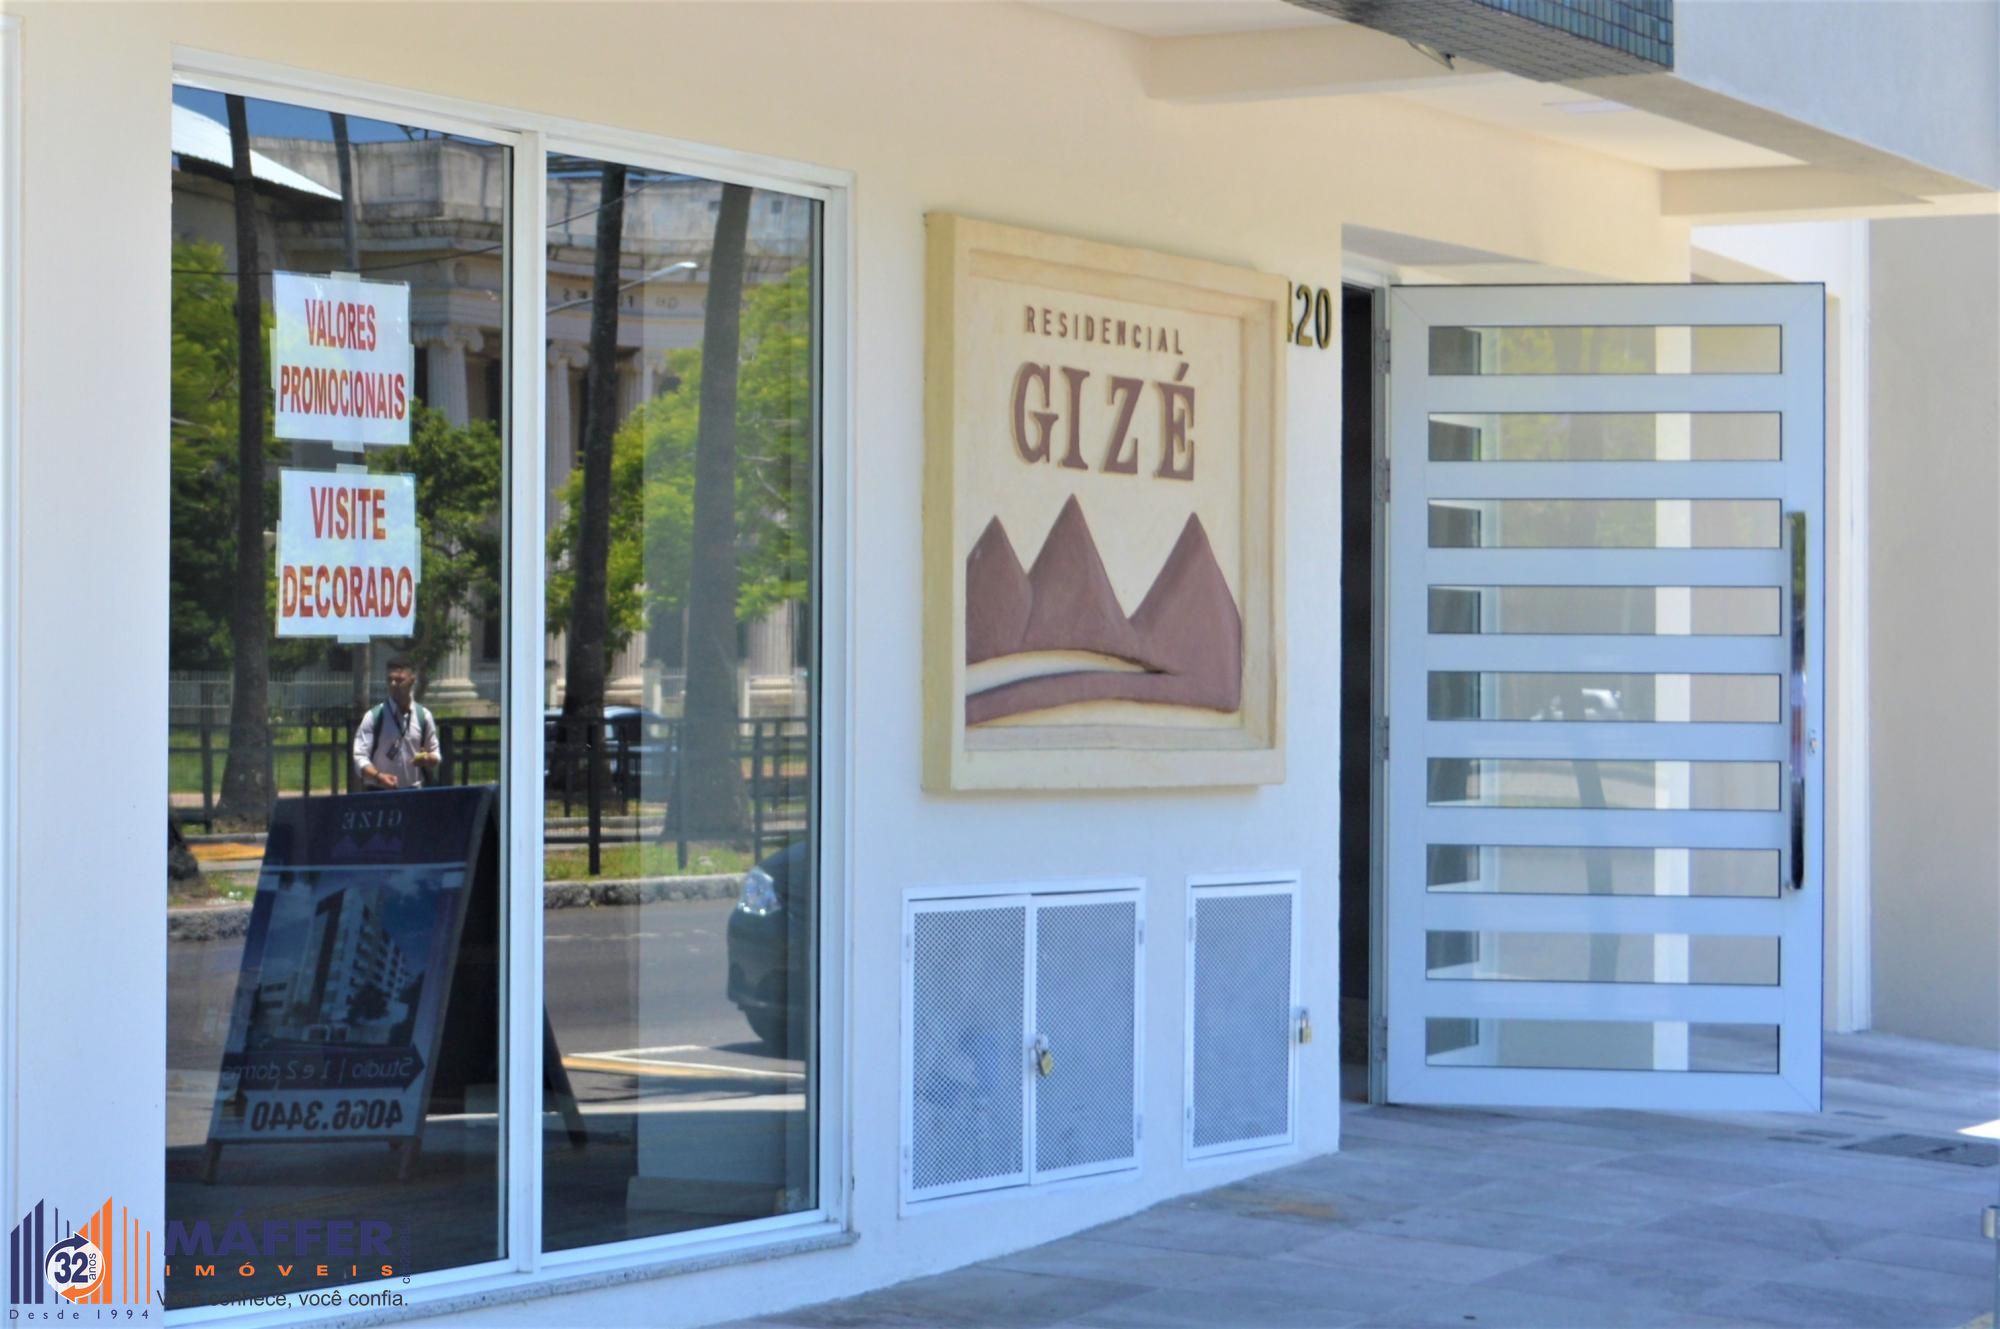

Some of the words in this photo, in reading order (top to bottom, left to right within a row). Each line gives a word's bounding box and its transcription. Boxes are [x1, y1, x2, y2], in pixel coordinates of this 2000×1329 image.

[305, 299, 376, 352] VALORES
[1024, 305, 1184, 355] RESIDENCIAL
[280, 364, 405, 421] PROMOCIONAIS
[1010, 362, 1195, 481] GIZÉ
[310, 486, 386, 540] VISITE
[282, 564, 413, 619] DECORADO
